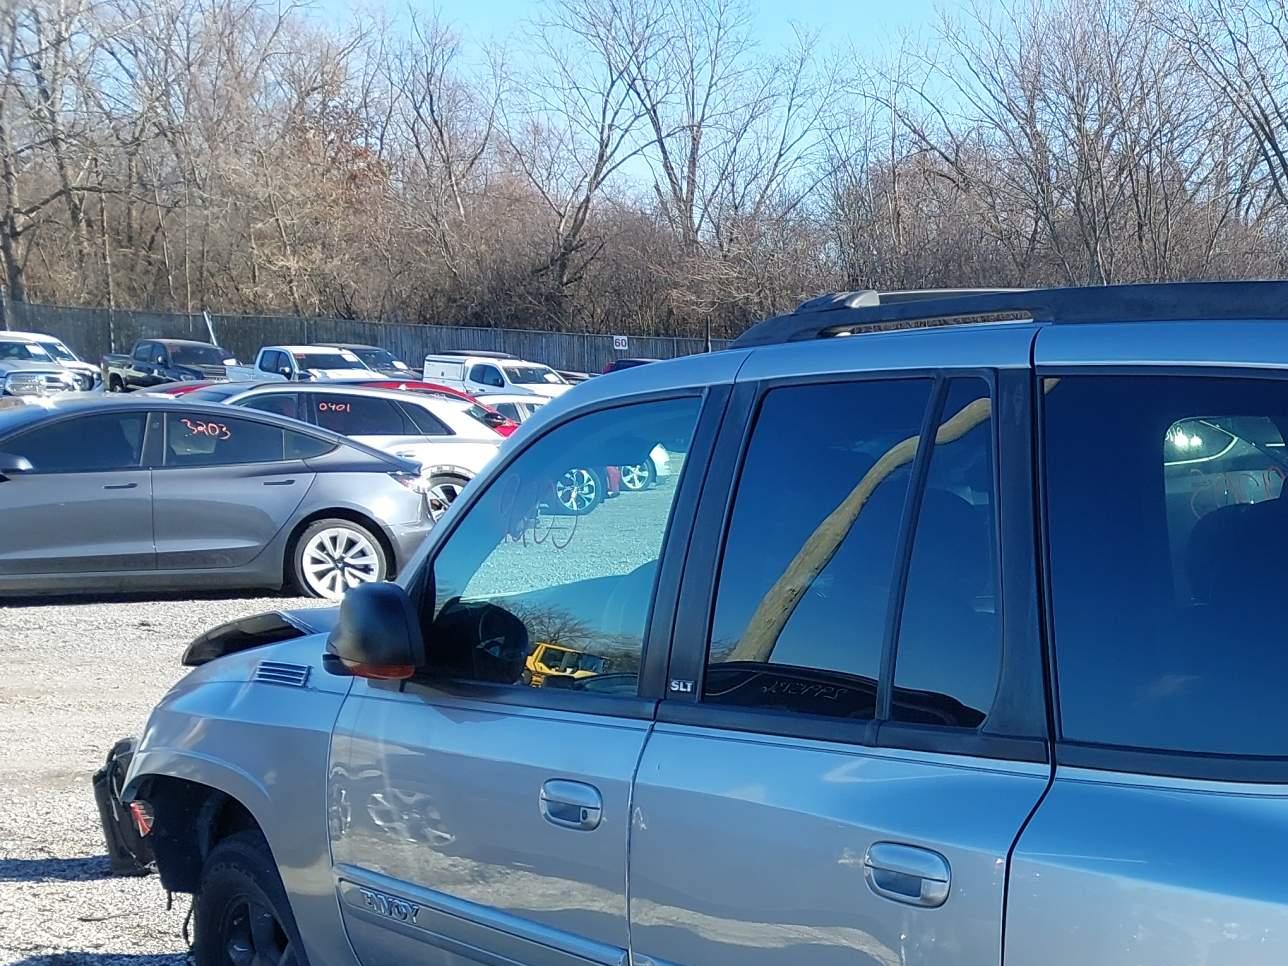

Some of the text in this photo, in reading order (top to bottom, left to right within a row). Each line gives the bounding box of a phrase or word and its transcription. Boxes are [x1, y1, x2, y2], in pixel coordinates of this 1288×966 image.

[615, 338, 627, 348] 60
[319, 402, 351, 413] 0401
[180, 418, 231, 440] 3203
[671, 680, 693, 692] SLT
[360, 889, 420, 925] ENVOY
